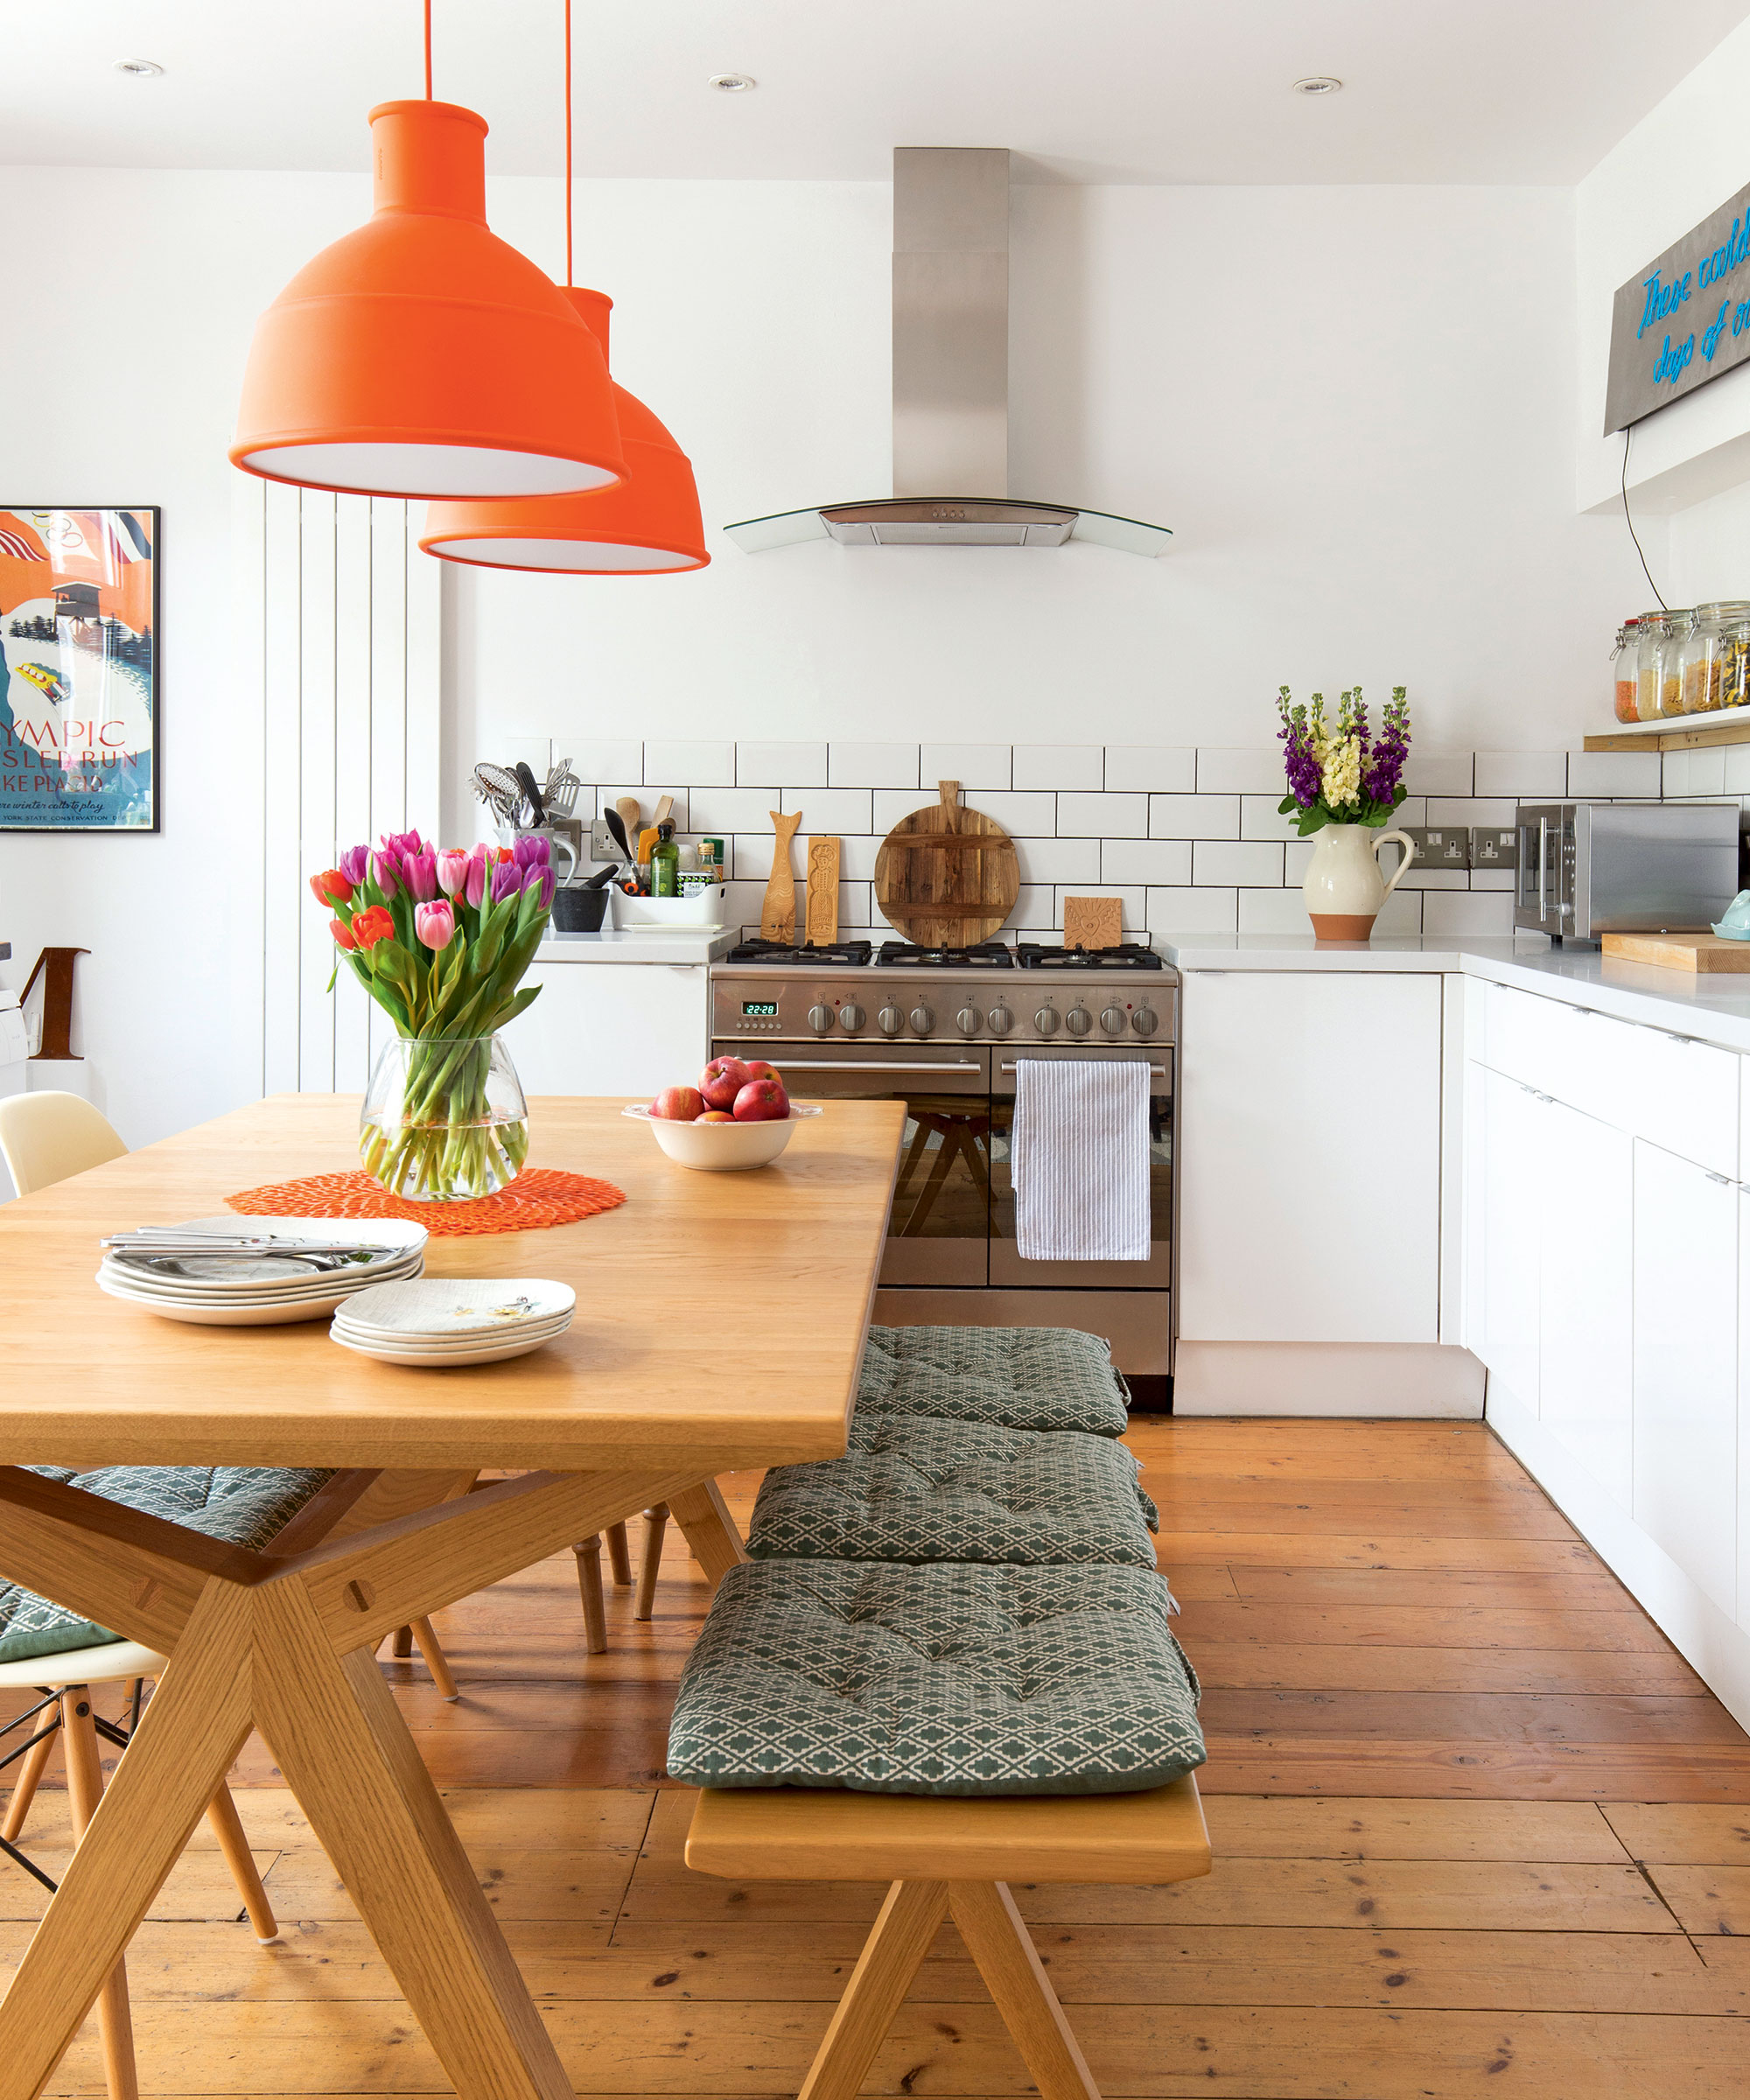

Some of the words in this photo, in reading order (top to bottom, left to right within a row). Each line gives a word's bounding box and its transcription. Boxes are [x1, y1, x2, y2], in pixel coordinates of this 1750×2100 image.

[1637, 269, 1691, 340] These
[1698, 206, 1750, 289] could
[1653, 333, 1694, 383] days
[1701, 300, 1730, 362] of
[3, 750, 72, 768] SLED
[82, 751, 137, 768] RUN
[3, 775, 28, 792] KE
[34, 775, 103, 792] PLACID
[12, 800, 46, 809] winter
[48, 800, 70, 809] calls
[80, 800, 104, 814] play
